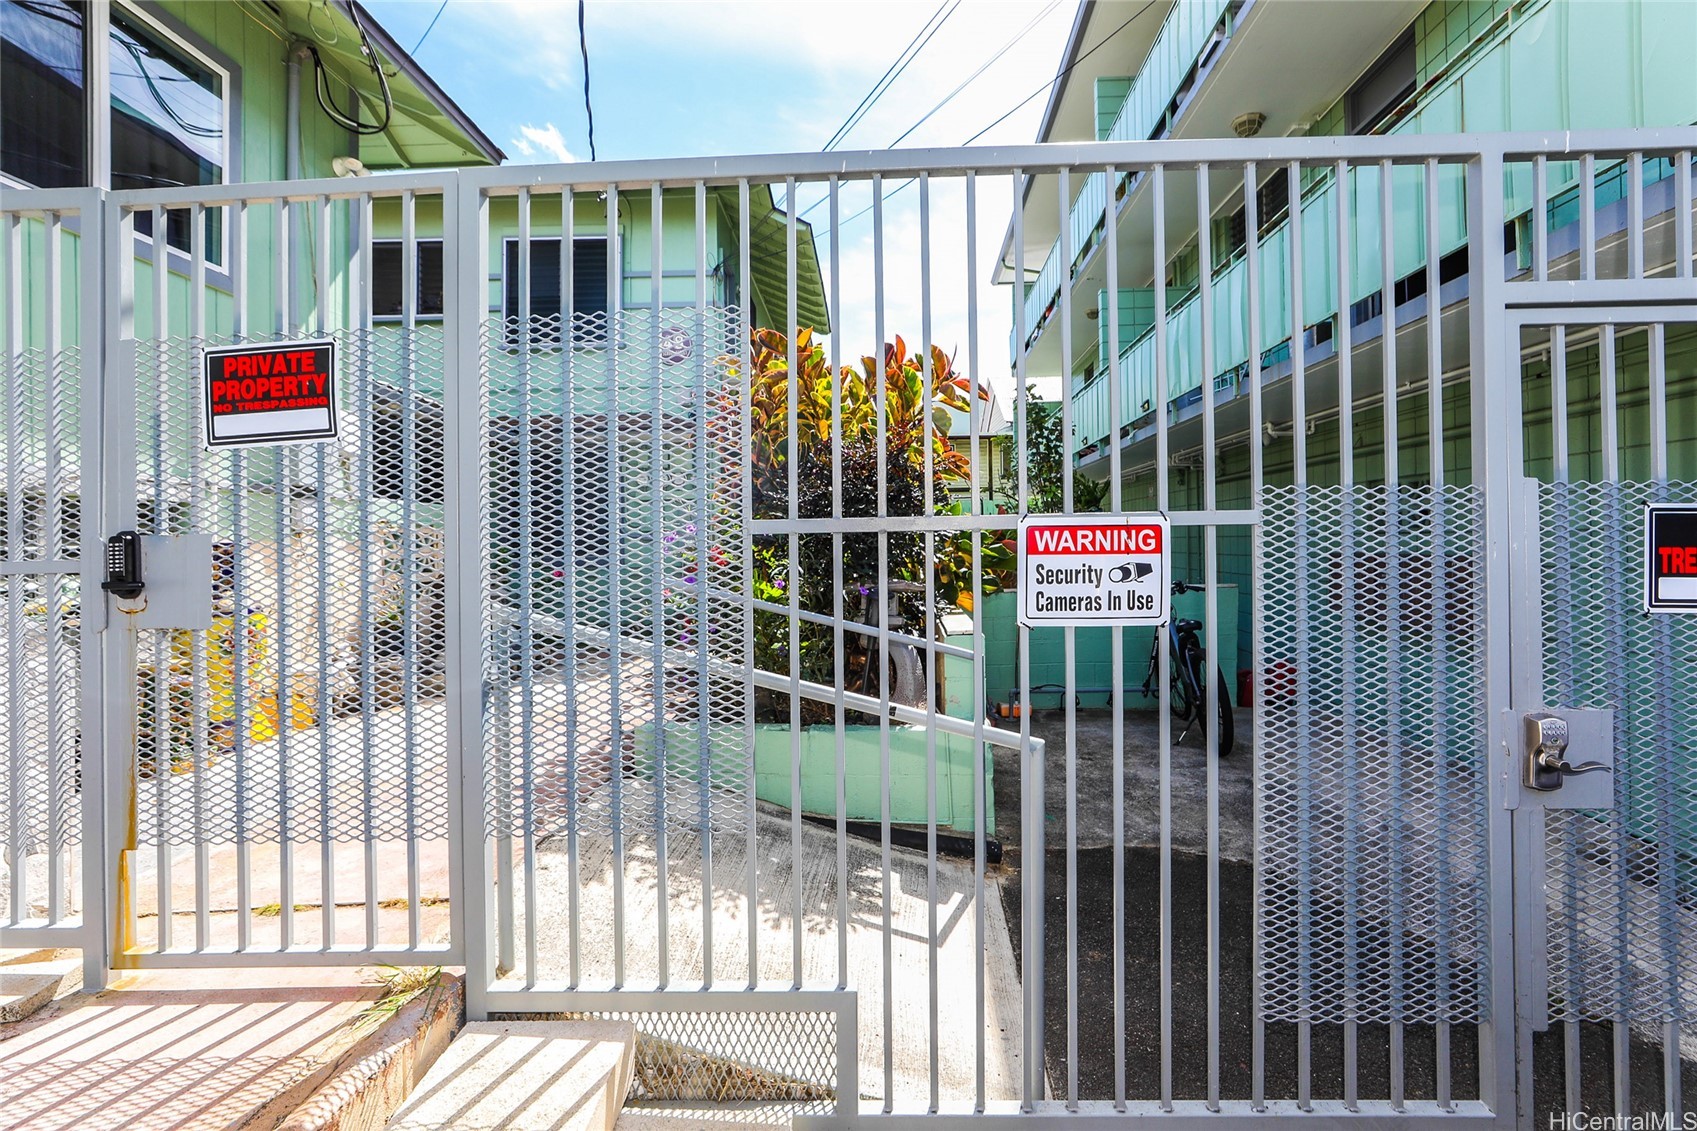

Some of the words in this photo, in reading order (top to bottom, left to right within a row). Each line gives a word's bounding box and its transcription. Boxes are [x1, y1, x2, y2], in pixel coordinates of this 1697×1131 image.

[223, 351, 316, 378] PRIVATE
[212, 373, 327, 402] PROPERTY
[213, 403, 233, 413] NO
[236, 396, 329, 411] TRESPASSING
[1034, 529, 1156, 552] WARNING
[1035, 563, 1103, 588] Security
[1035, 591, 1102, 612] Cameras
[1107, 590, 1121, 611] In
[1127, 589, 1154, 611] Use
